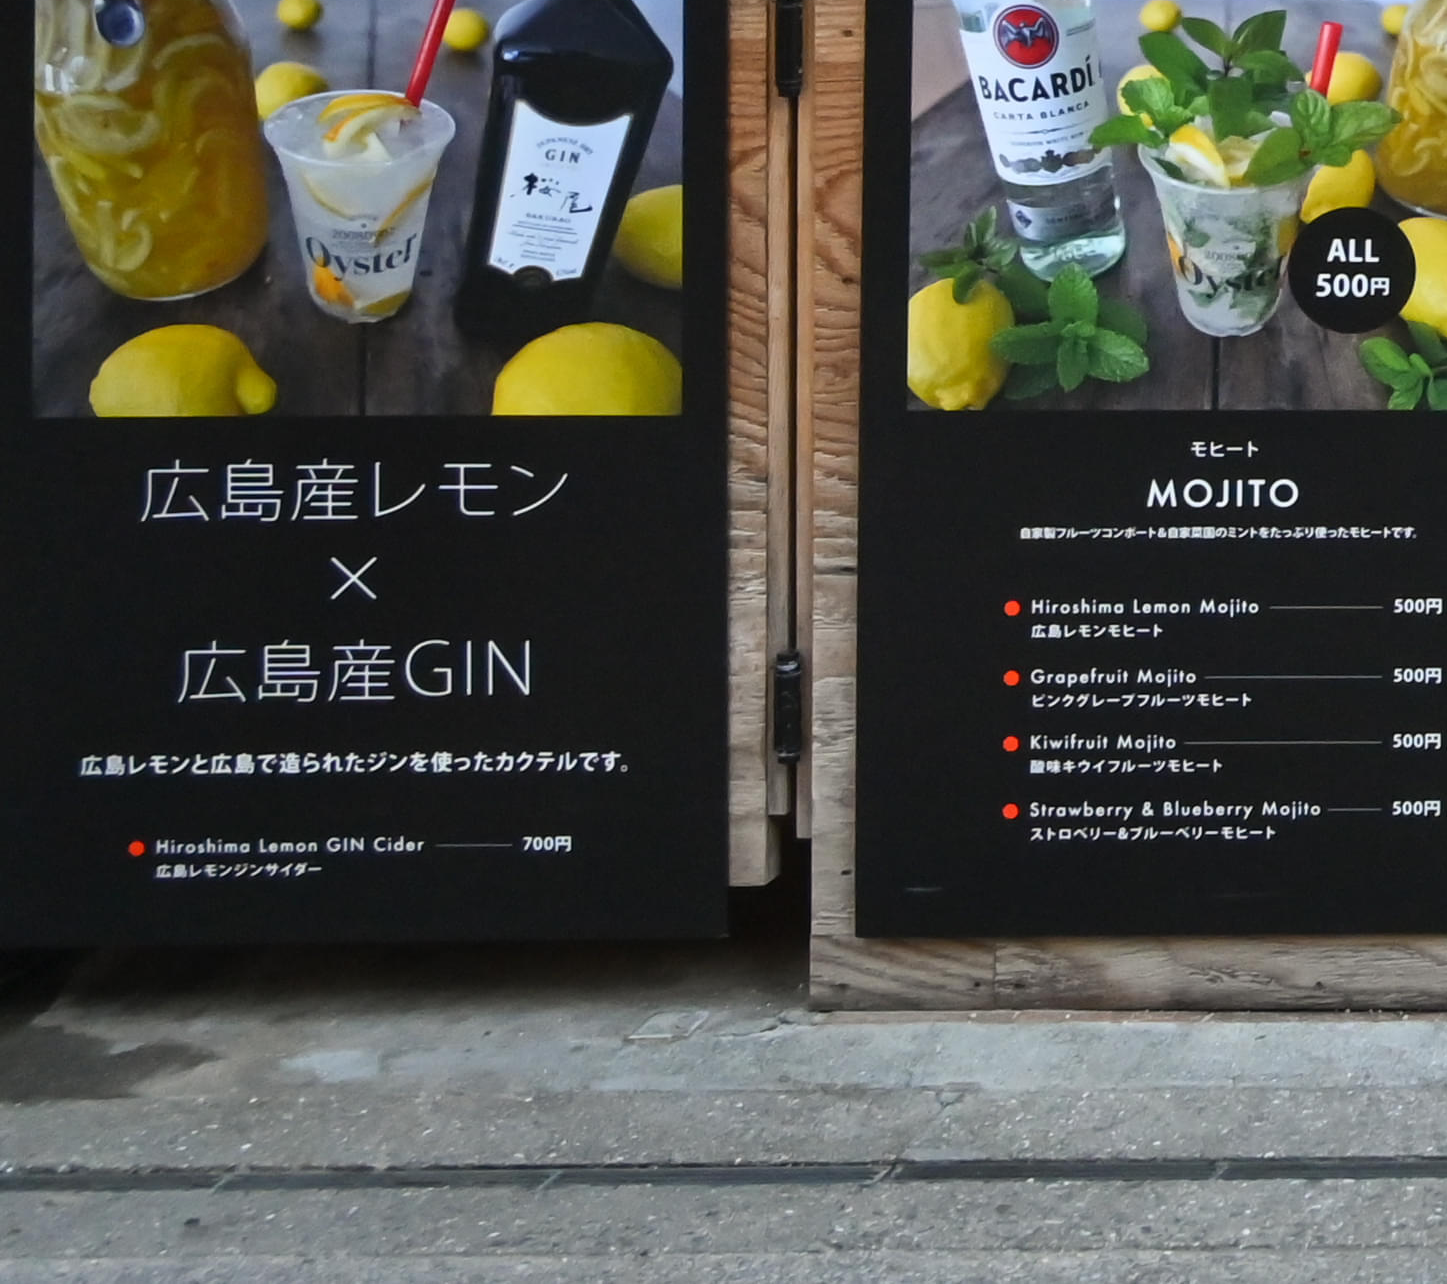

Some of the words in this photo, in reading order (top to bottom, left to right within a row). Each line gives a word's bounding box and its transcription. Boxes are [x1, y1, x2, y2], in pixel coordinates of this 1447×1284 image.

[978, 55, 1096, 103] BACARDÍ
[992, 111, 1035, 122] CARTA
[1039, 100, 1090, 121] BLANCA
[544, 148, 581, 164] GIN
[521, 172, 594, 214] 桜尾
[305, 232, 418, 282] Oyster
[1326, 237, 1380, 263] ALL
[1315, 273, 1390, 298] 500円
[1190, 440, 1259, 458] モヒート
[140, 457, 569, 522] 広島産レモン
[1146, 478, 1299, 508] MOJITO
[1031, 597, 1125, 615] Hiroshima
[1132, 598, 1191, 614] Lemon
[1199, 598, 1260, 618] Mojito
[1393, 597, 1443, 615] 500円
[1030, 623, 1164, 639] 広島レモンモヒート
[177, 638, 530, 703] 広島産GIN
[1030, 667, 1129, 688] Grapefruit
[1136, 668, 1197, 688] Mojito
[1393, 667, 1443, 685] 500円
[1031, 692, 1252, 708] ピンクグレープフルーツモヒート
[1030, 732, 1109, 750] Kiwifruit
[1116, 734, 1177, 754] Mojito
[1392, 732, 1442, 750] 500円
[80, 750, 628, 776] 広島レモンと広島で造られたジンを使ったカクテルです。
[1029, 758, 1223, 775] 酸味キウイフルーツモヒート
[1029, 800, 1134, 821] Strawberry
[1141, 801, 1155, 817] &
[1163, 800, 1254, 821] Blueberry
[1261, 800, 1321, 820] Mojito
[1391, 800, 1441, 817] 500円
[522, 835, 572, 853] 700円
[1030, 825, 1276, 842] ストロベリー&ブルーベリーモヒート
[155, 837, 251, 855] Hiroshima
[259, 838, 318, 854] Lemon
[326, 837, 365, 853] GIN
[373, 835, 425, 853] Cider
[155, 862, 322, 879] 広島レモンジンサイダー
